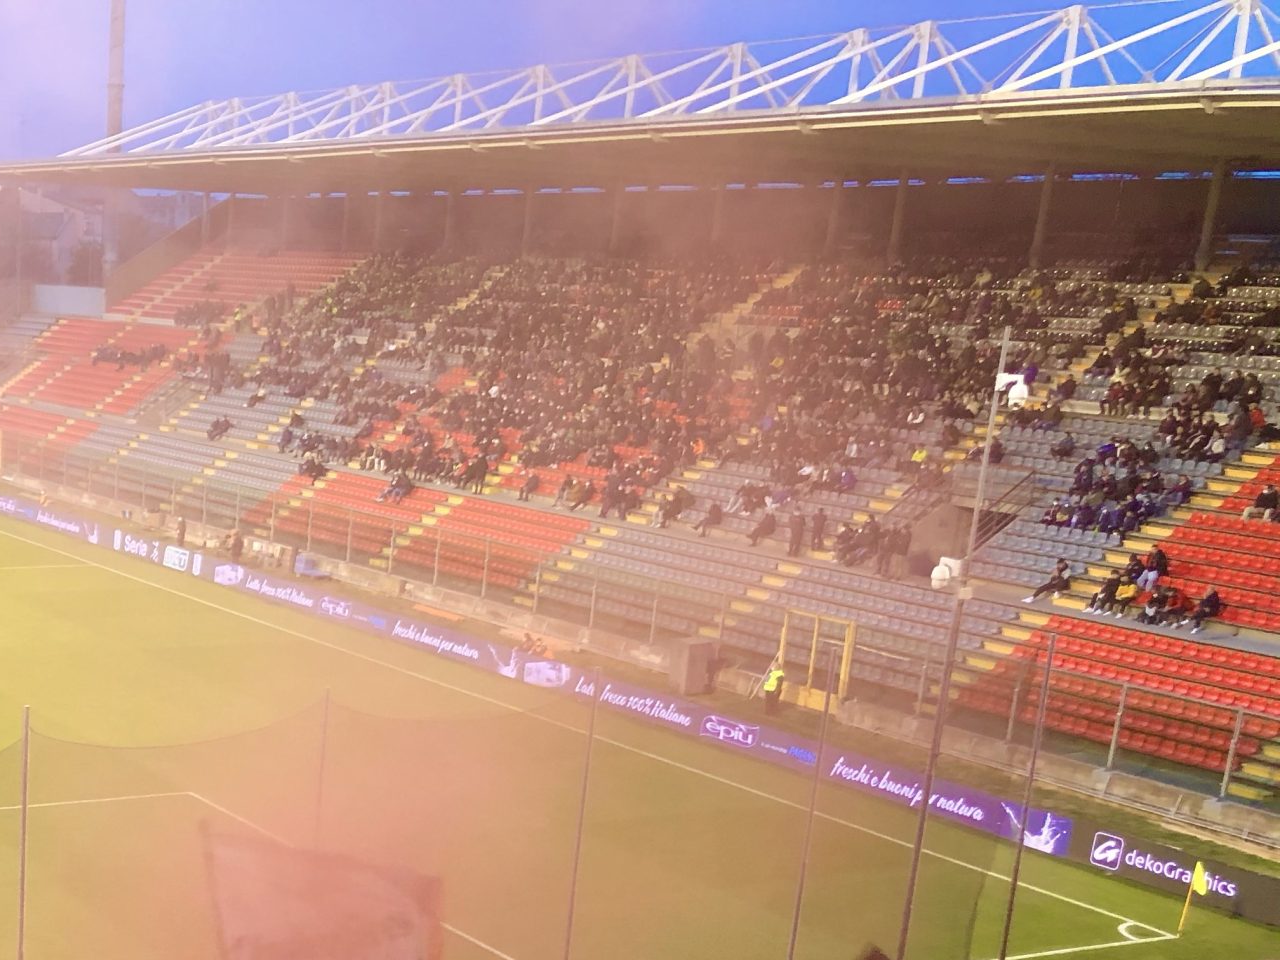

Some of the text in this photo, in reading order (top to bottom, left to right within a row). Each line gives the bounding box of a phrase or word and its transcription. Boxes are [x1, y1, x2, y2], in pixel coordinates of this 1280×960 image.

[124, 535, 148, 557] Serie
[627, 696, 654, 714] 100%
[649, 700, 692, 727] Italiano
[829, 756, 985, 821] freschi e buoni pr natura
[1124, 849, 1237, 897] dekoGrahics
